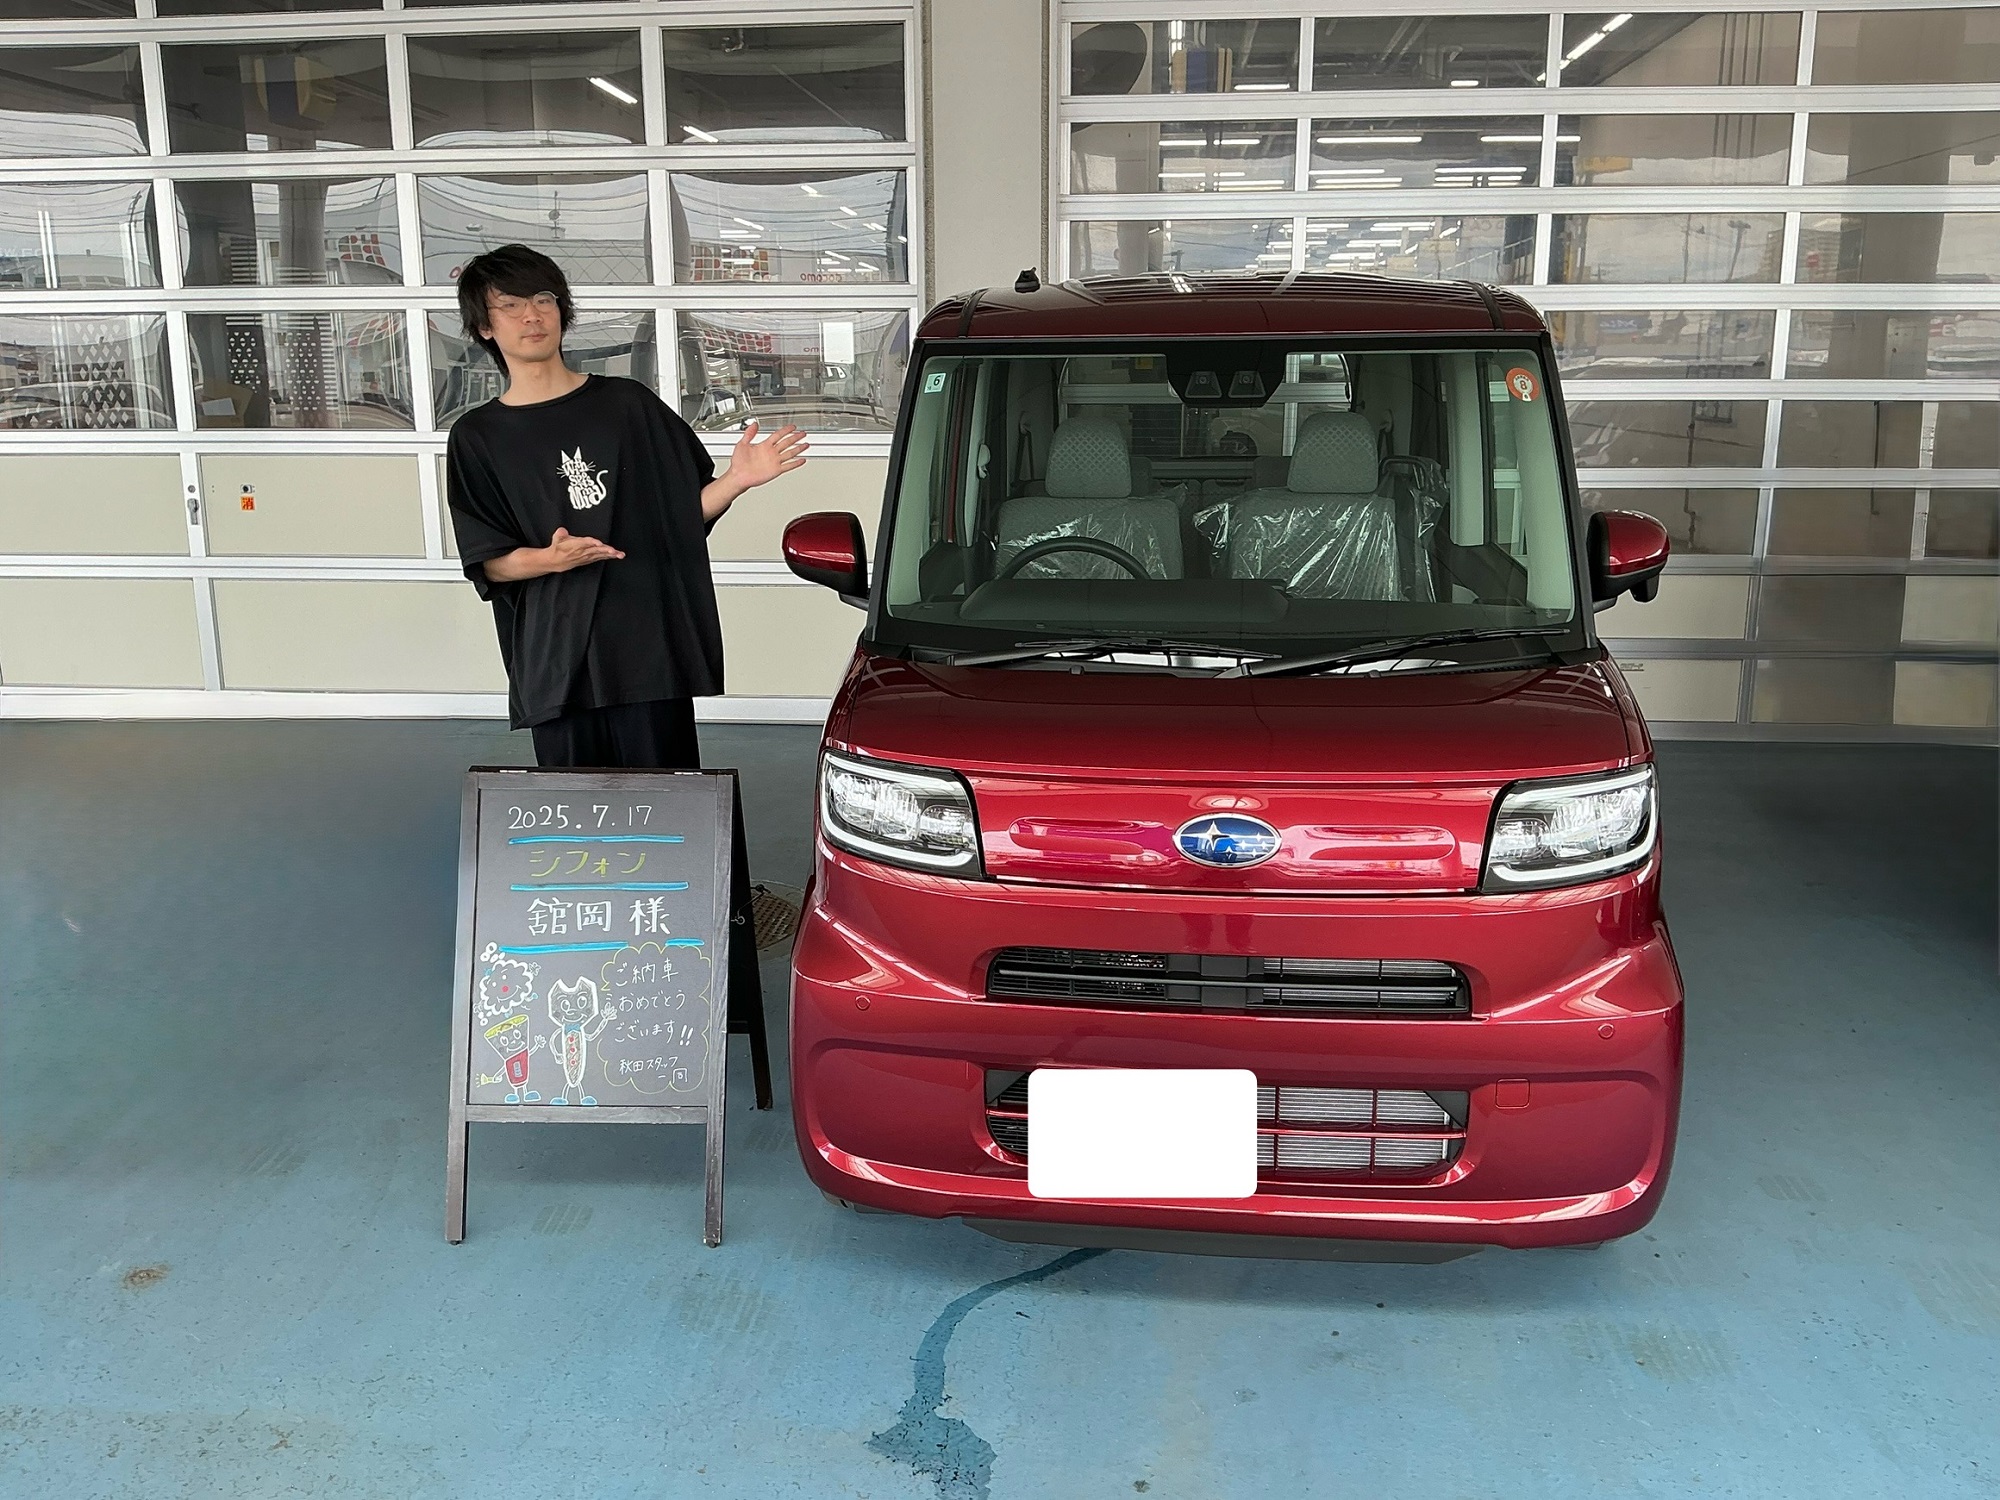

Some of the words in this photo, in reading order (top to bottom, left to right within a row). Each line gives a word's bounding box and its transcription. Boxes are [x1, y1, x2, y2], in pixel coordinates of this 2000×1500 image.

[933, 375, 942, 386] 6
[1519, 380, 1528, 390] 8
[529, 850, 646, 878] シフォン
[615, 957, 679, 987] ご納車
[618, 989, 686, 1012] おめでとう
[618, 1056, 679, 1075] 秋田スタッフ
